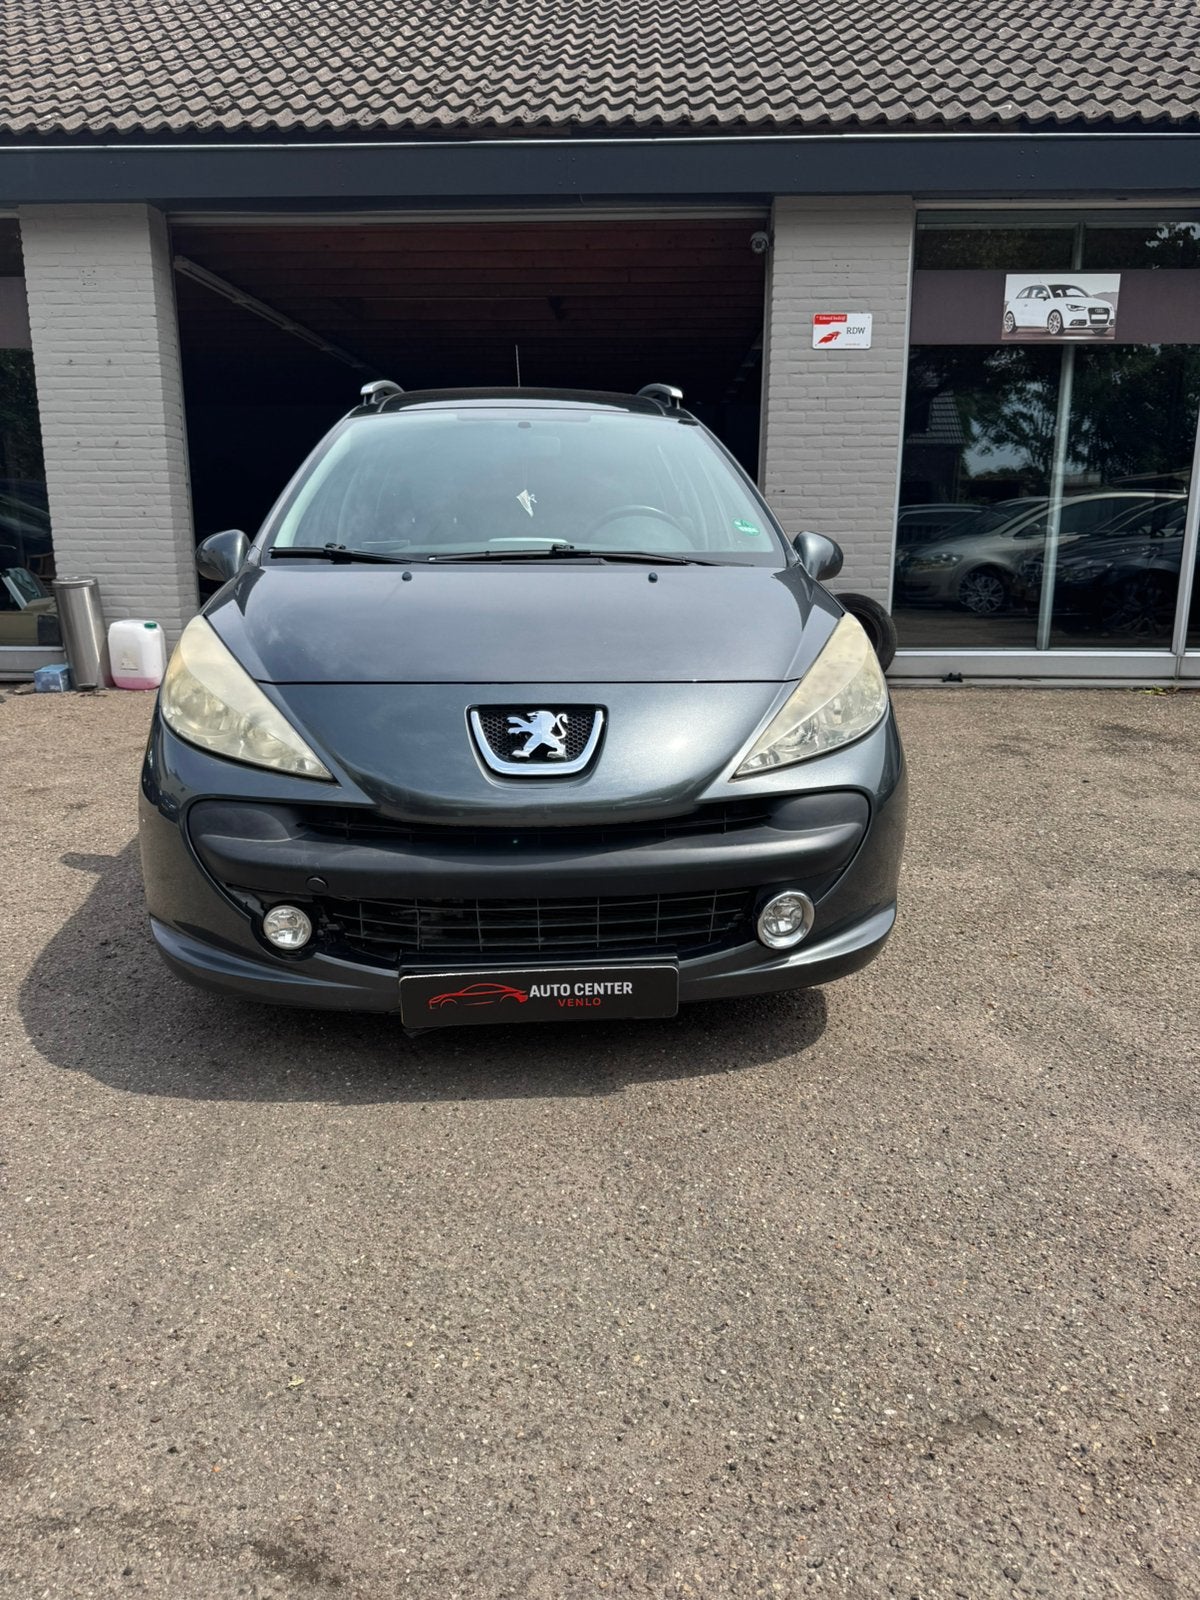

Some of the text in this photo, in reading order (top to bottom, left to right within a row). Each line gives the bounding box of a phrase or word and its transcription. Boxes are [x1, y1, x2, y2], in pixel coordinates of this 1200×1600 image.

[846, 327, 865, 335] RDW
[529, 982, 633, 998] AUTO CENTER
[558, 997, 602, 1007] VENLO
